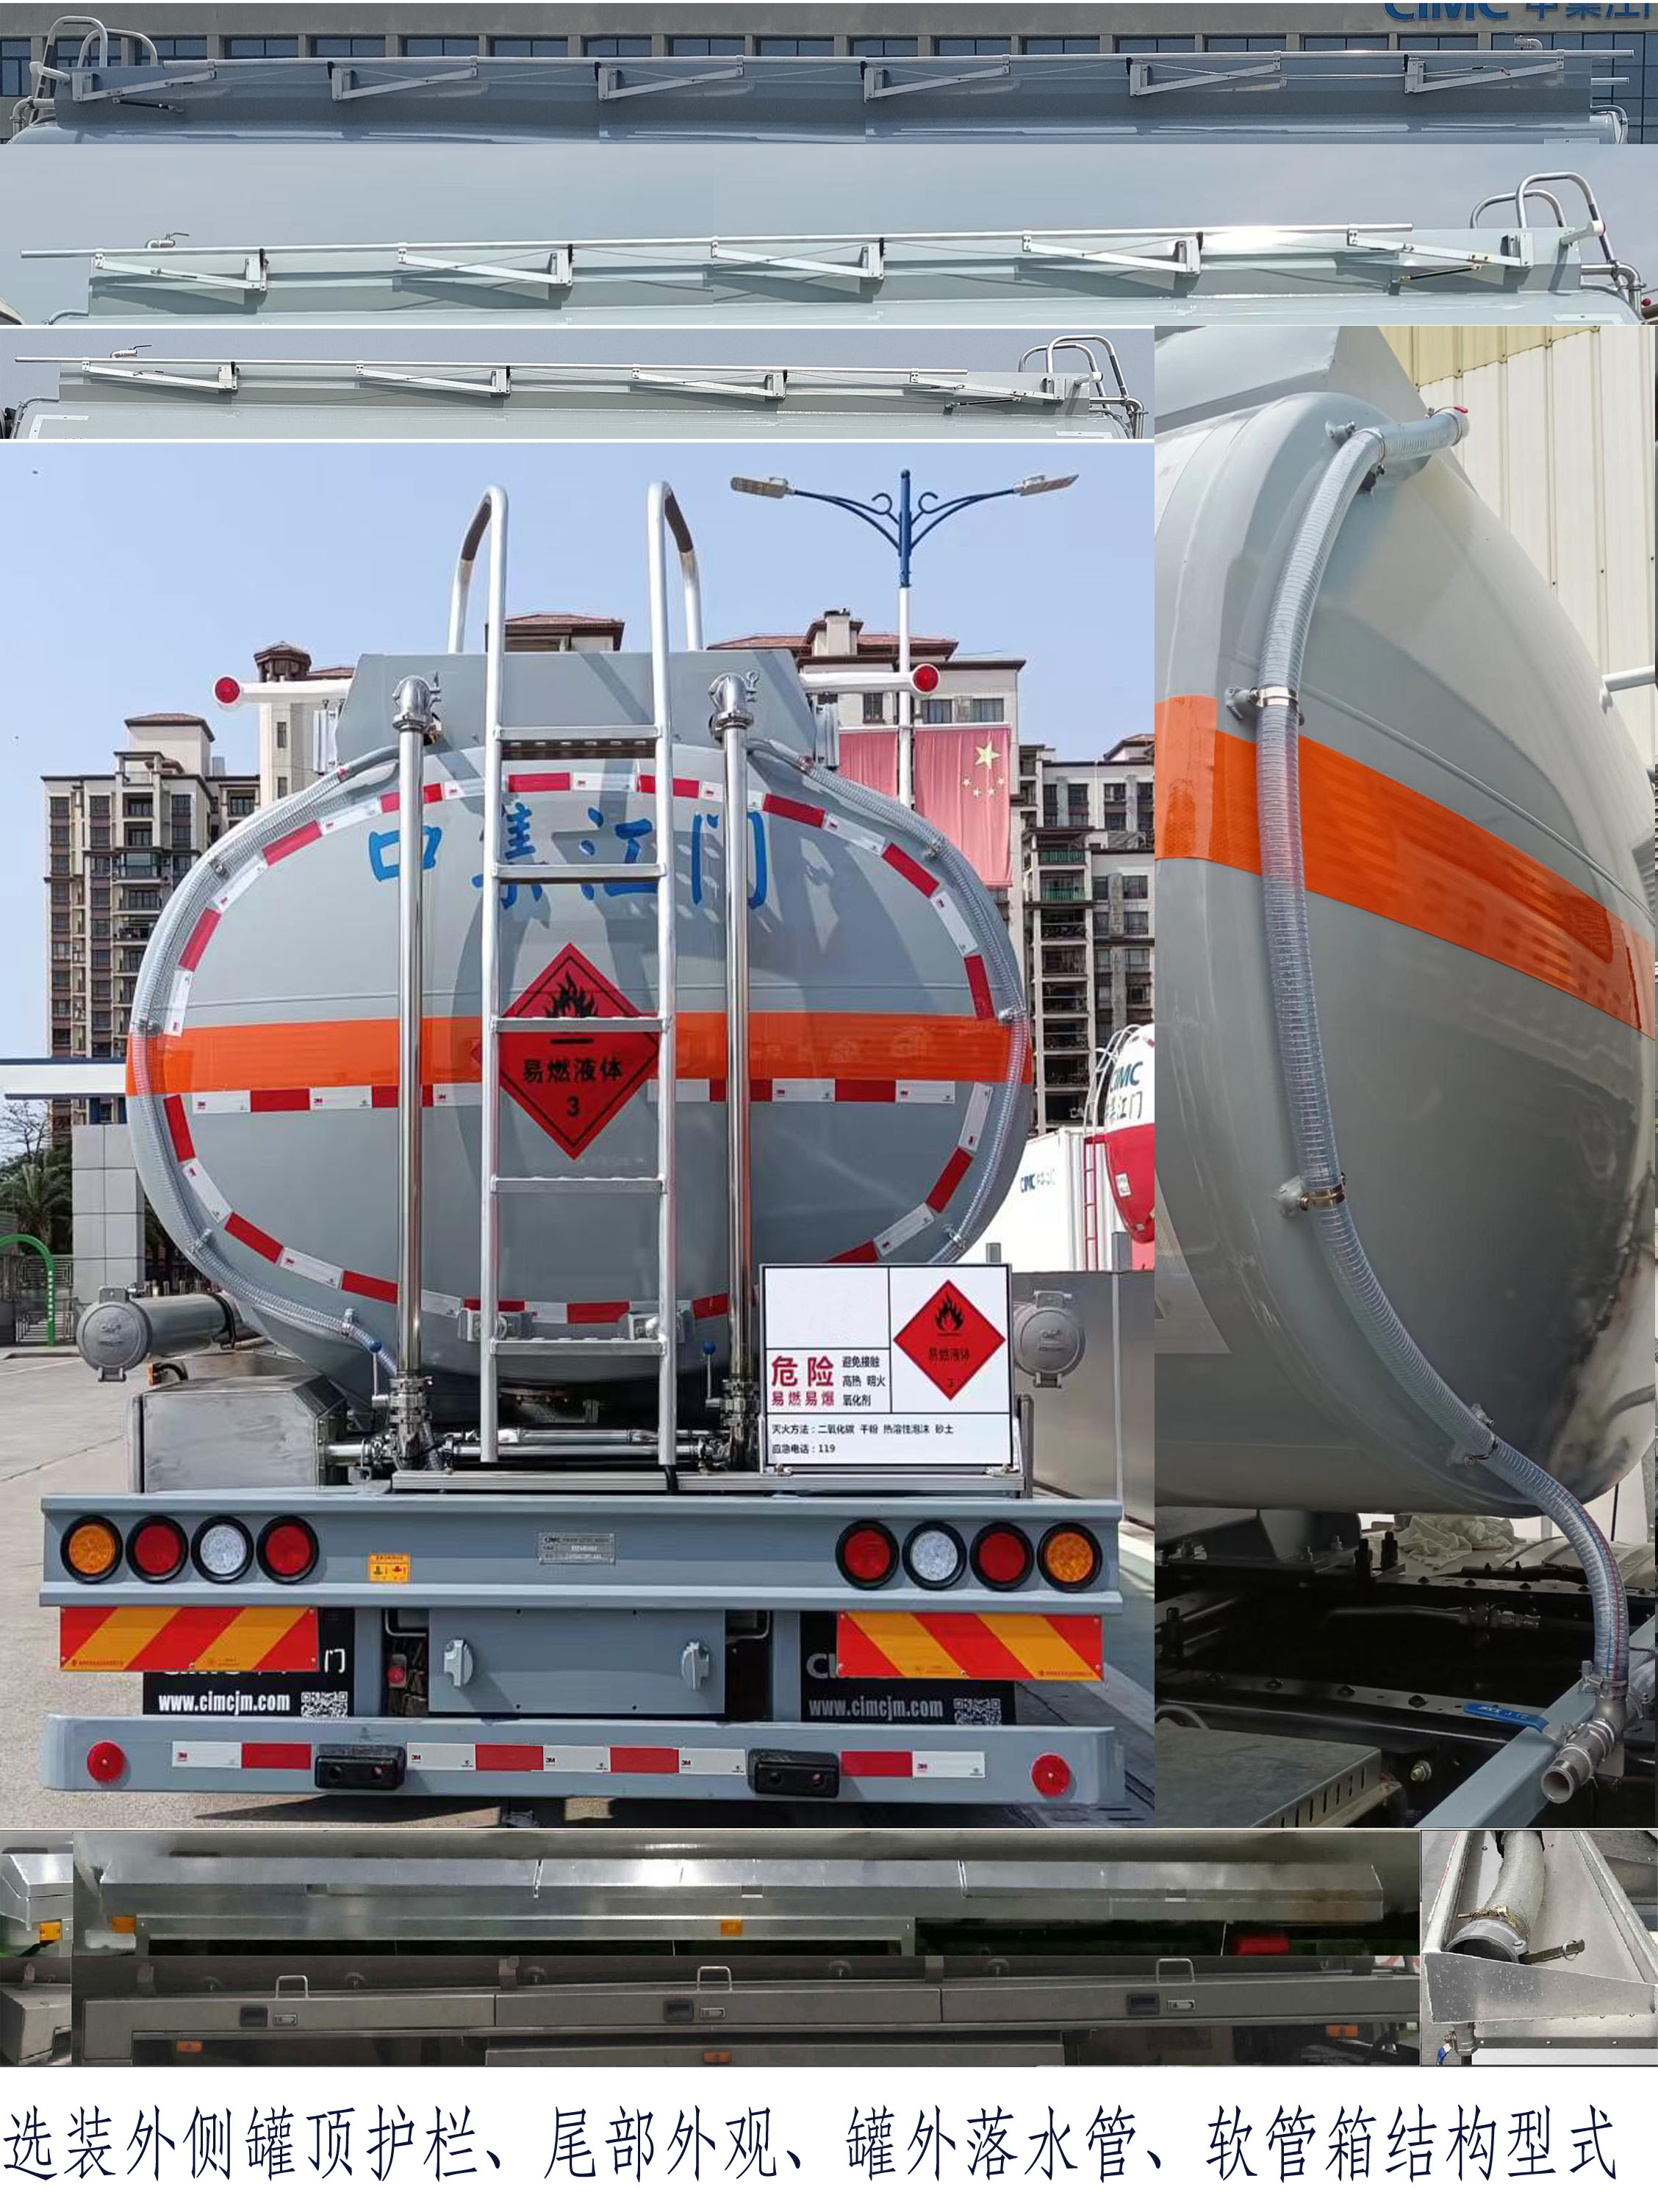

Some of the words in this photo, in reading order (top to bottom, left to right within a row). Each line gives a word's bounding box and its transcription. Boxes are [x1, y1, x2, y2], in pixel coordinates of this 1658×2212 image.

[523, 1056, 622, 1085] 易燃液体
[566, 1095, 581, 1117] 3
[772, 1355, 834, 1387] 危险
[842, 1356, 880, 1368] 避免接触
[842, 1375, 862, 1387] 高热
[866, 1375, 886, 1387] 明火
[772, 1391, 835, 1406] 易燃易爆
[843, 1394, 872, 1407] 氧化剂
[158, 1691, 290, 1715] www.cimcjm.com
[808, 1695, 944, 1721] www.cimcjm.com
